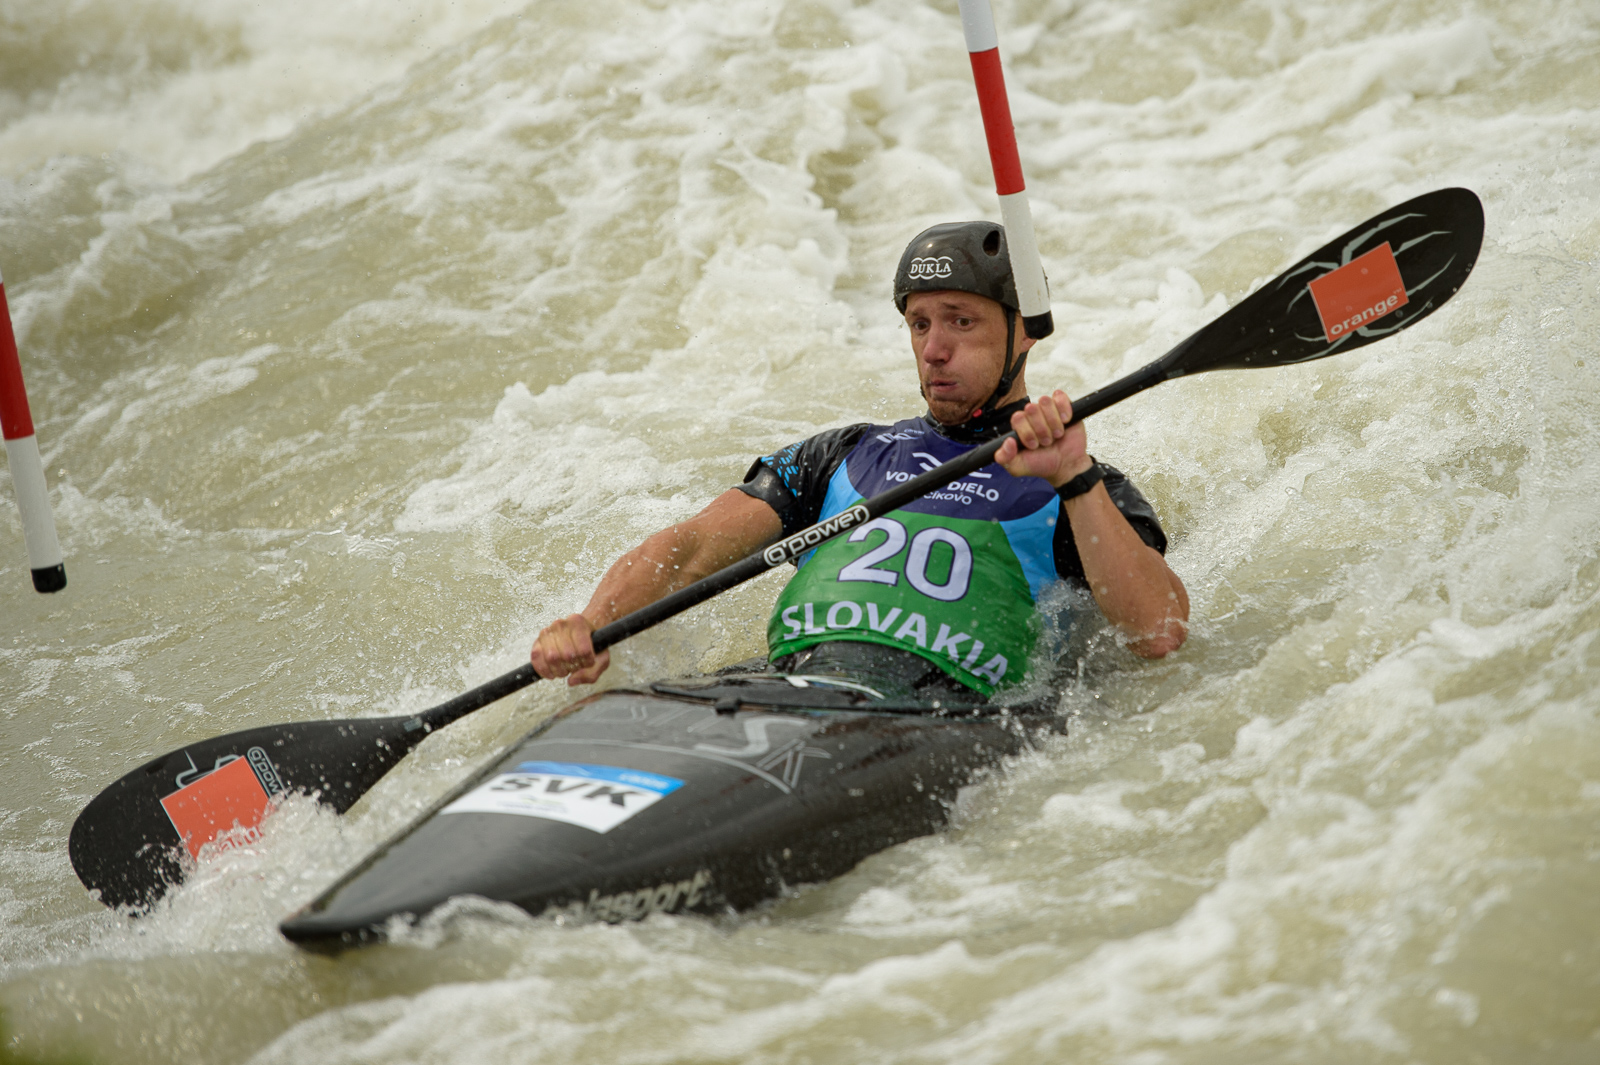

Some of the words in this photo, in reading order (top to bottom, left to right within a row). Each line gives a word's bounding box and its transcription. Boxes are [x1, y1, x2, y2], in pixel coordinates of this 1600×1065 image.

[910, 262, 951, 274] DUKLA
[1330, 294, 1399, 336] orange
[947, 481, 1000, 502] DIELO
[837, 516, 974, 602] 20
[781, 600, 1009, 686] SLOVAKIA
[489, 776, 646, 808] SVK
